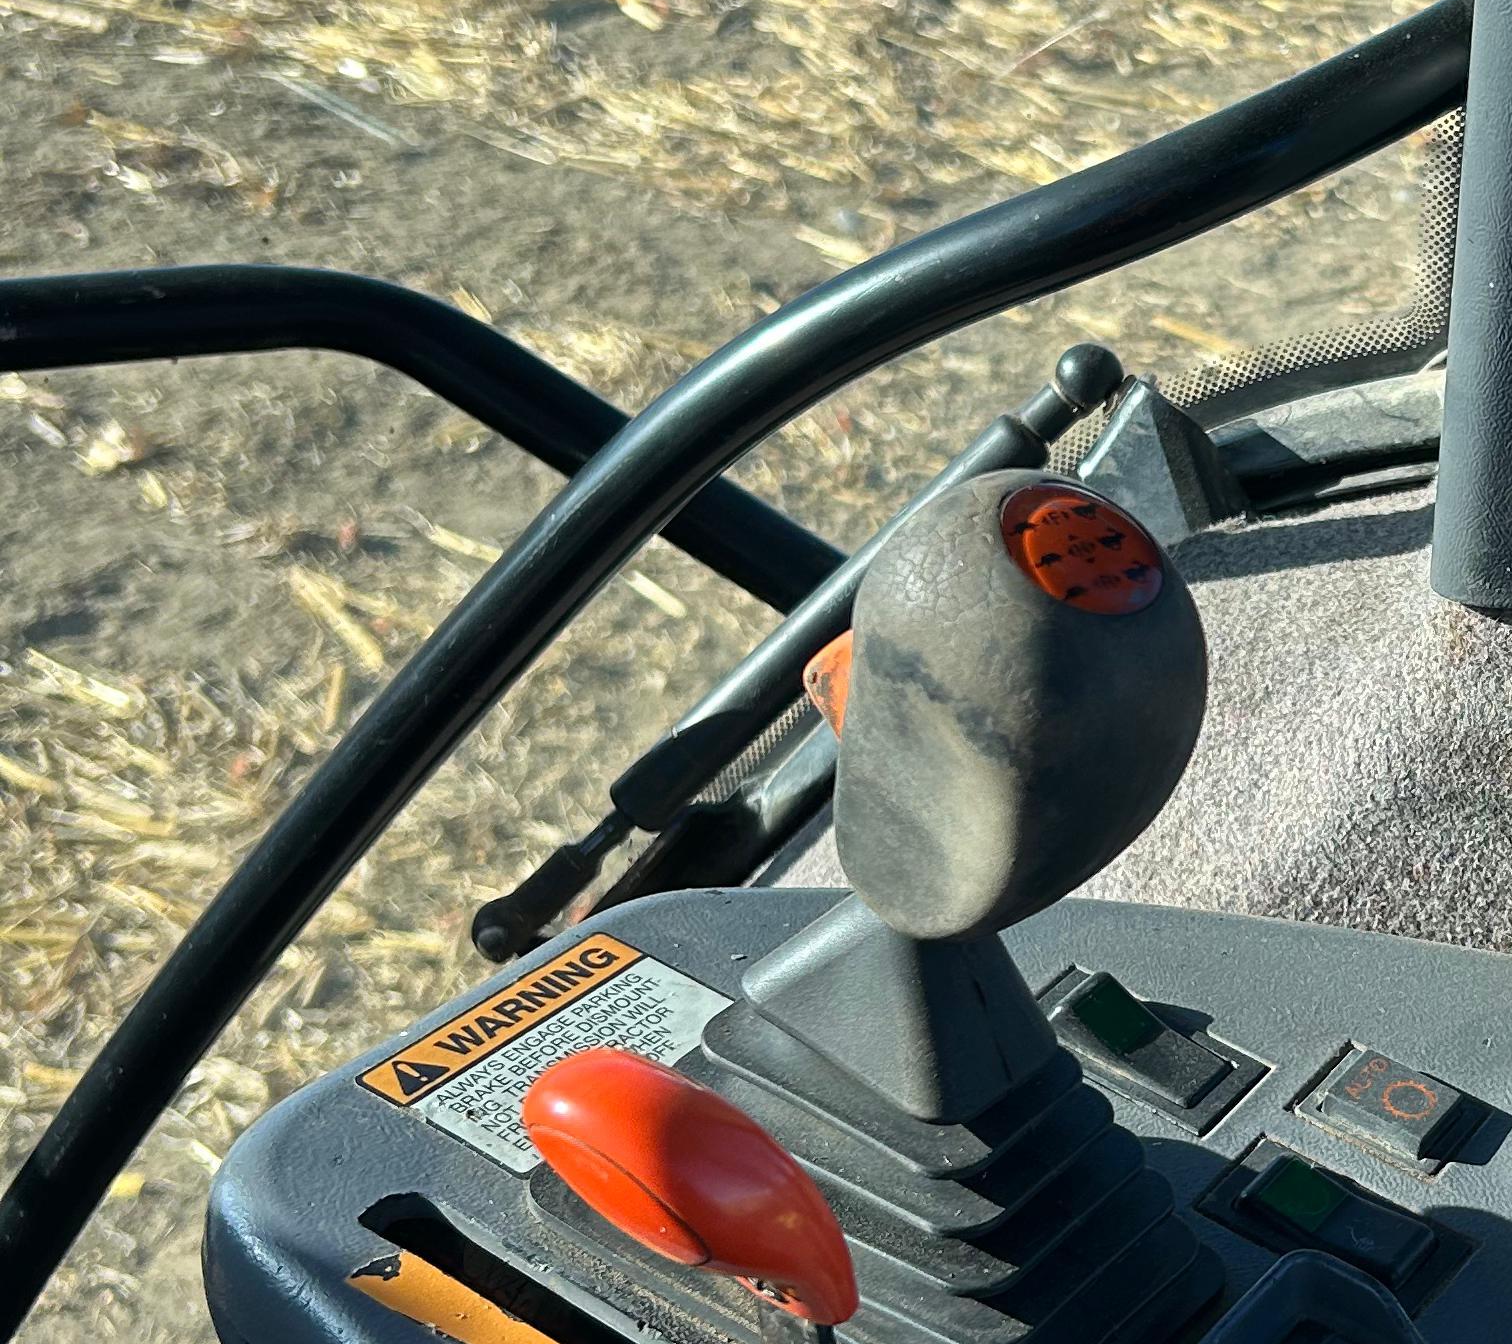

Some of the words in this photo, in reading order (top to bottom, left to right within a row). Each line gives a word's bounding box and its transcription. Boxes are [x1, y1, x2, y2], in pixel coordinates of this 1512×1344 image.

[433, 948, 620, 1055] WARNING
[436, 1059, 506, 1106] ALWAYS
[501, 1015, 576, 1062] ENGAGE
[570, 973, 642, 1018] PARKING
[448, 1073, 513, 1113] BRAKE
[508, 1030, 581, 1076] BEFORE
[575, 977, 662, 1033] DISMOUNT-
[621, 996, 666, 1020] WILL
[481, 1104, 520, 1133] NOT
[599, 1006, 675, 1049] RACTOR
